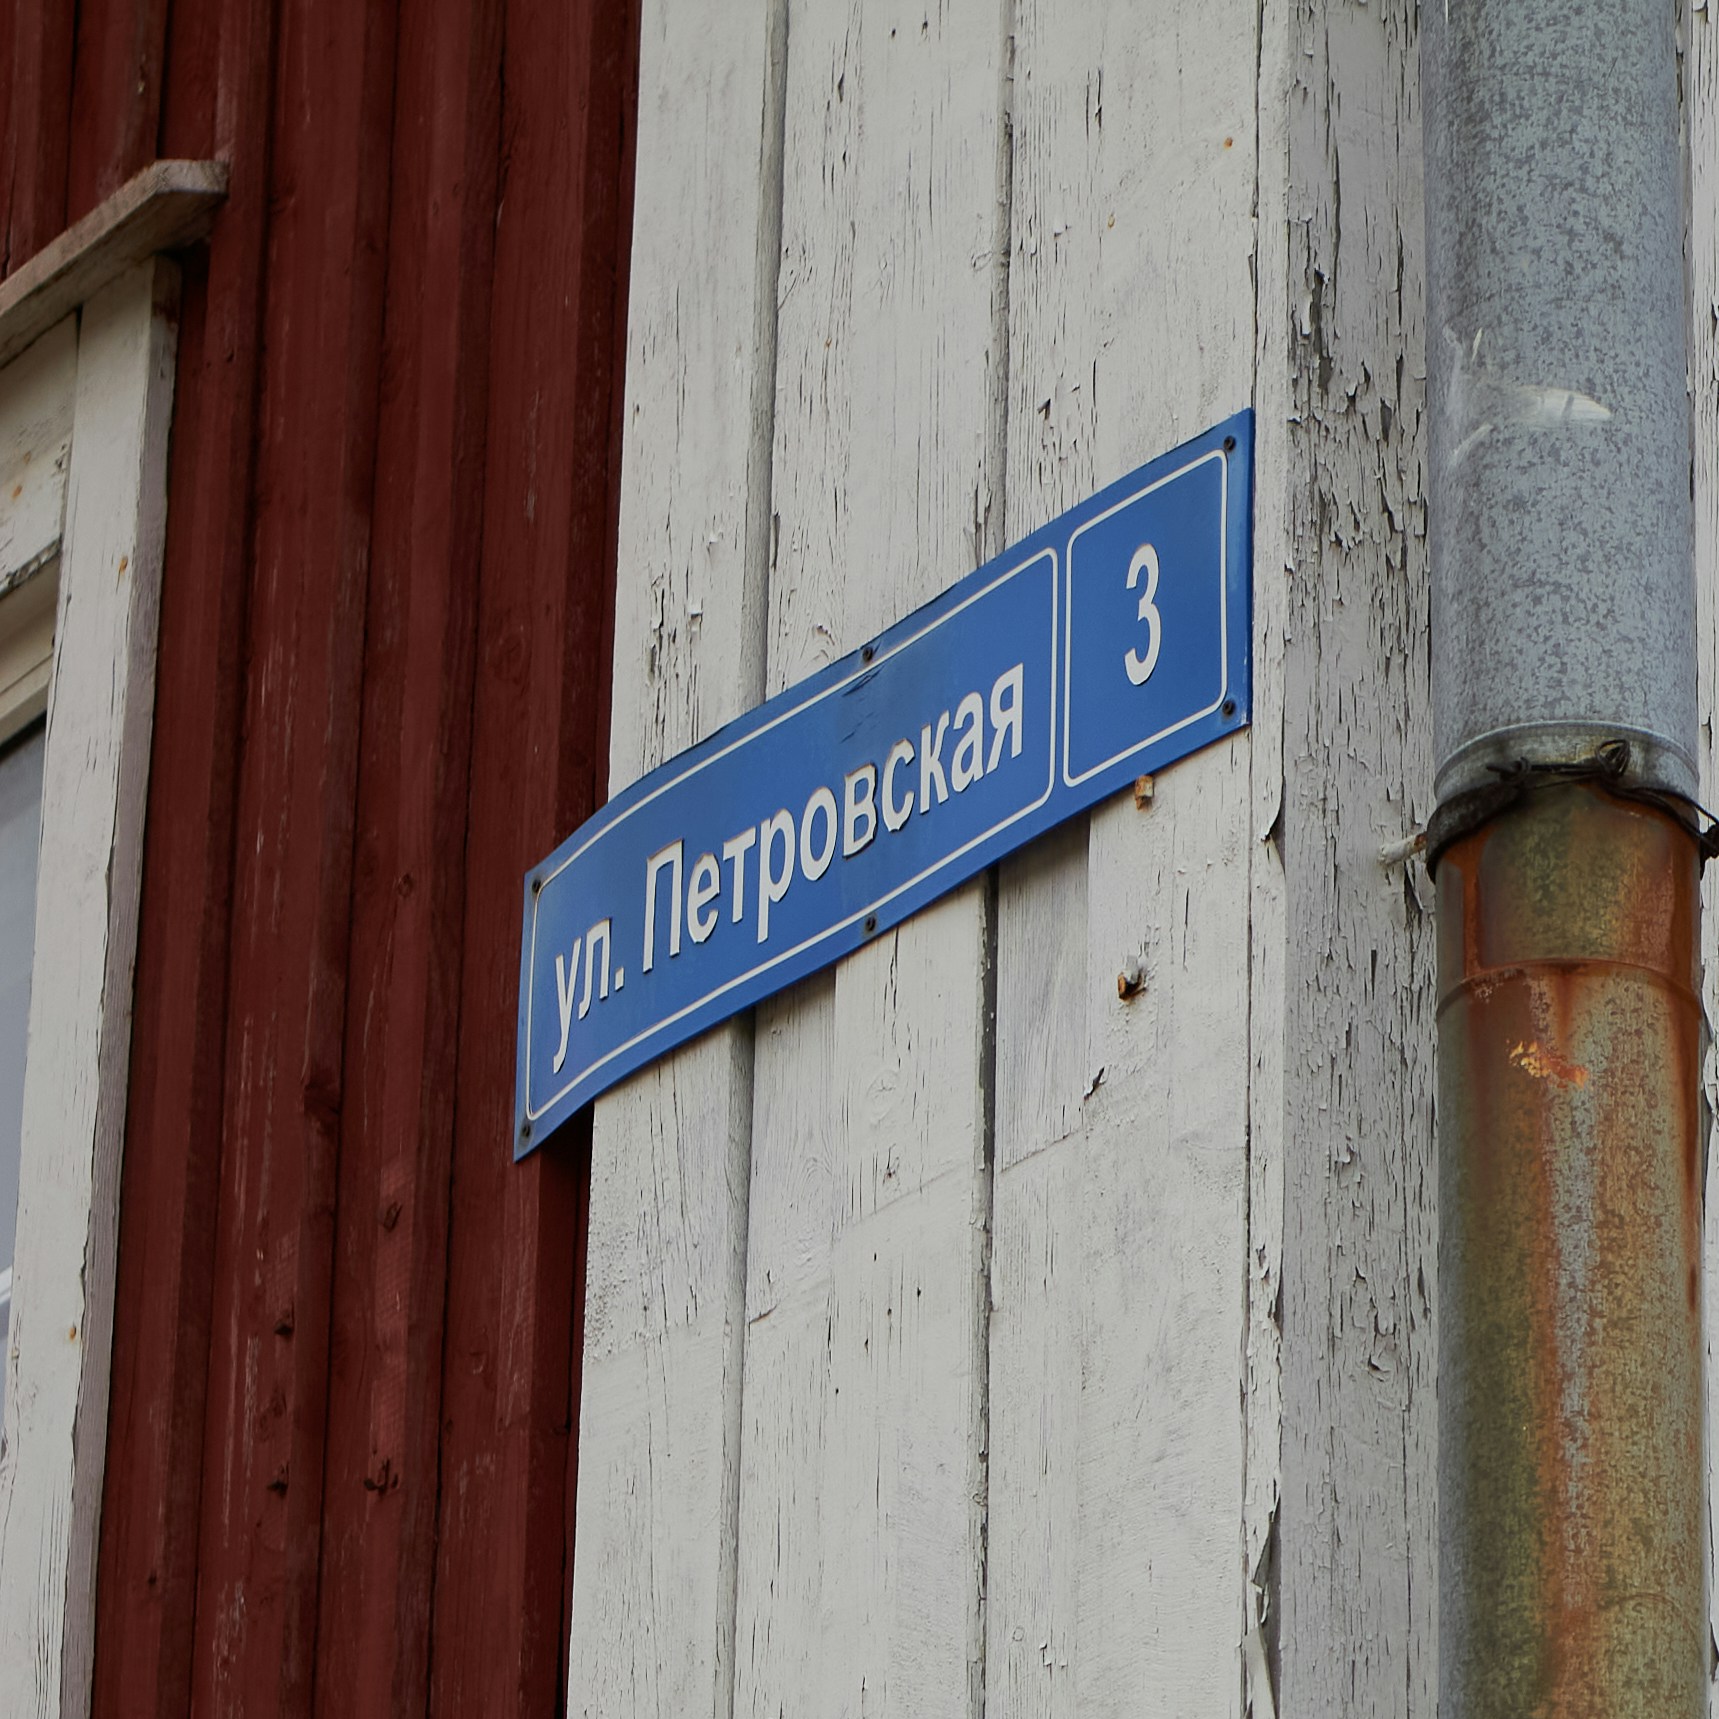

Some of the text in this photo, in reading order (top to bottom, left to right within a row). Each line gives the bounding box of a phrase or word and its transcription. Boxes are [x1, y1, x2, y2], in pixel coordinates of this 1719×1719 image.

[1124, 543, 1162, 686] 3
[553, 663, 1024, 1074] ул. Петровская
